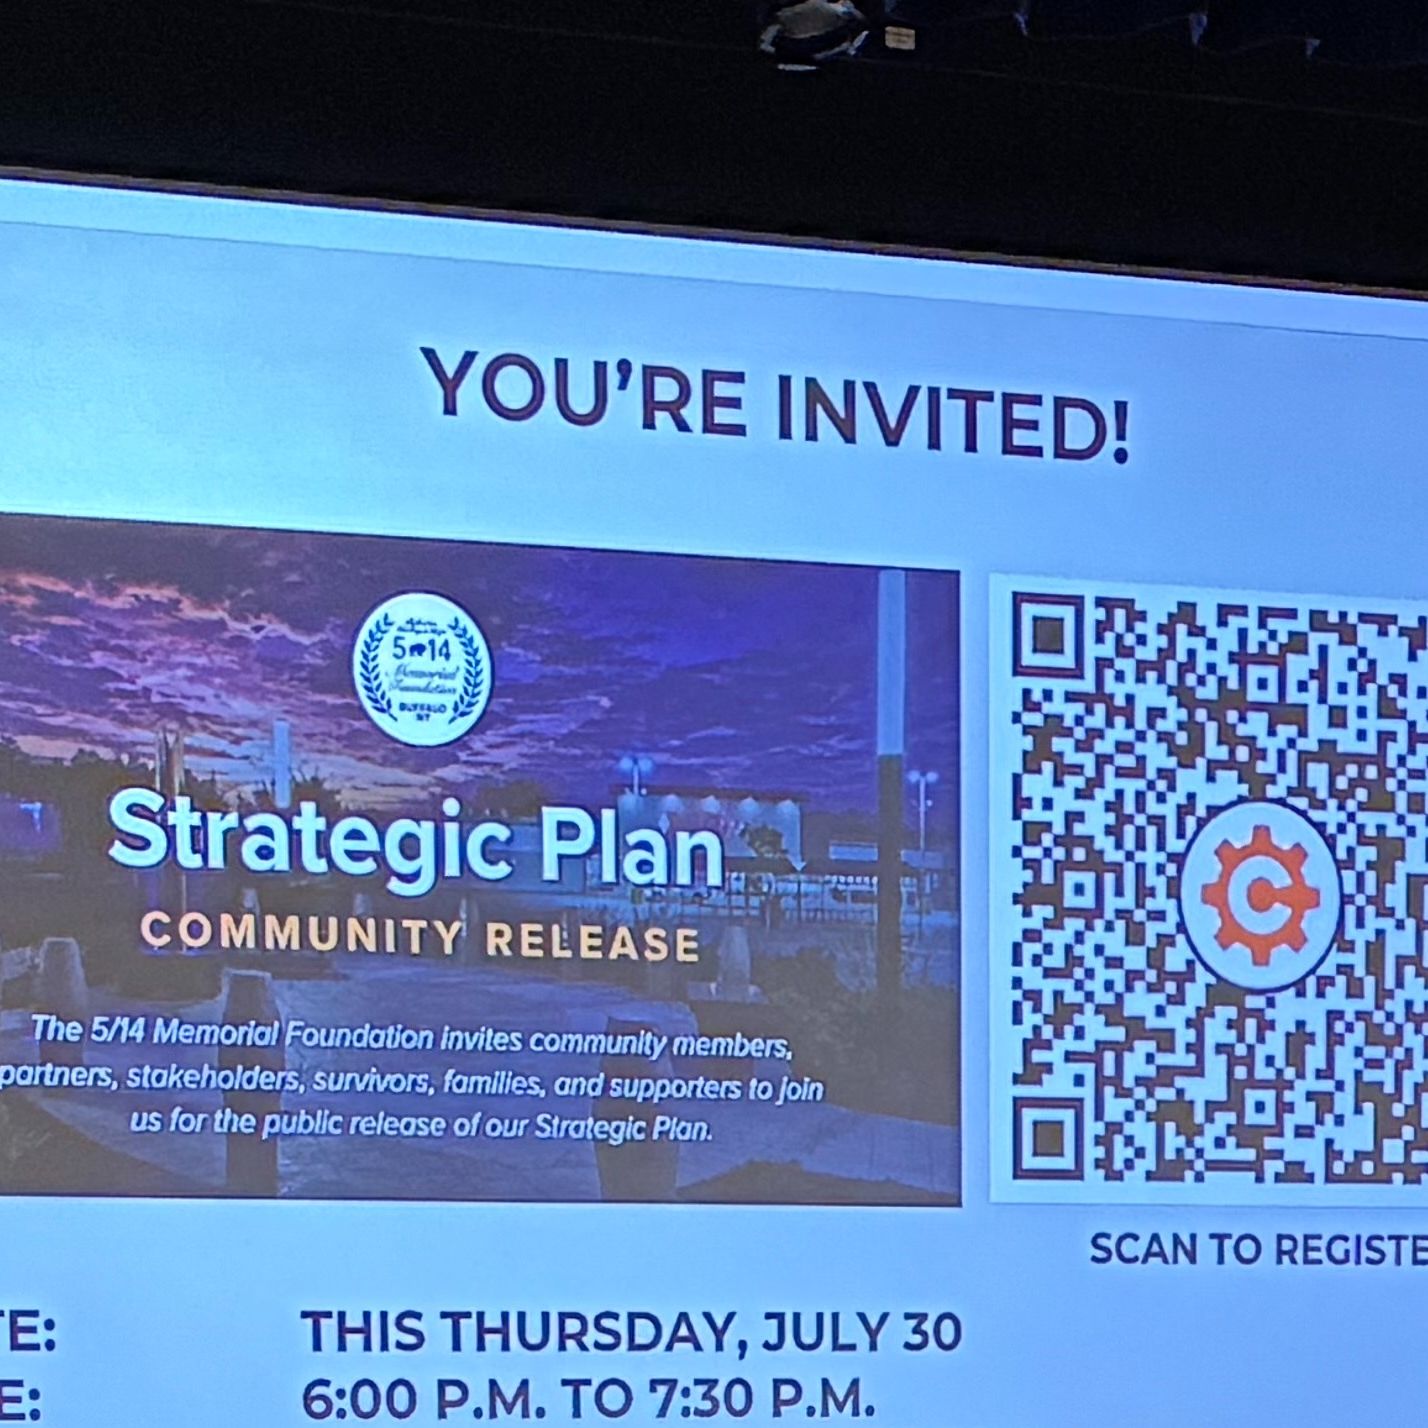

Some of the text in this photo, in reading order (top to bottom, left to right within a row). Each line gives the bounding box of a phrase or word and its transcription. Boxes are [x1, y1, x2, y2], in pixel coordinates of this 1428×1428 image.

[420, 347, 1128, 464] YOU'RE INVITED!
[392, 635, 406, 659] 5
[109, 786, 723, 896] Strategic Plan
[141, 911, 698, 961] COMMUNITY RELEASE
[32, 1014, 792, 1060] The 5/14 Memorial Foundation invites community members,
[127, 1064, 304, 1093] stakeholders,
[313, 1067, 434, 1095] survivors,
[444, 1069, 545, 1097] families,
[554, 1073, 604, 1096] and
[610, 1077, 741, 1103] supporters
[750, 1078, 772, 1099] to
[775, 1076, 823, 1105] join
[131, 1107, 712, 1145] us for the public release of our Strategic Plan.
[1091, 1232, 1197, 1264] SCAN
[1209, 1233, 1261, 1265] TO
[301, 1310, 425, 1352] THIS
[440, 1311, 747, 1360] THURSDAY,
[762, 1312, 889, 1351] JULY
[903, 1312, 961, 1351] 30
[303, 1378, 416, 1419] 6:00
[437, 1379, 545, 1420] P.M.
[561, 1378, 633, 1418] TO
[649, 1377, 753, 1418] 7:30
[773, 1378, 874, 1417] P.M.
